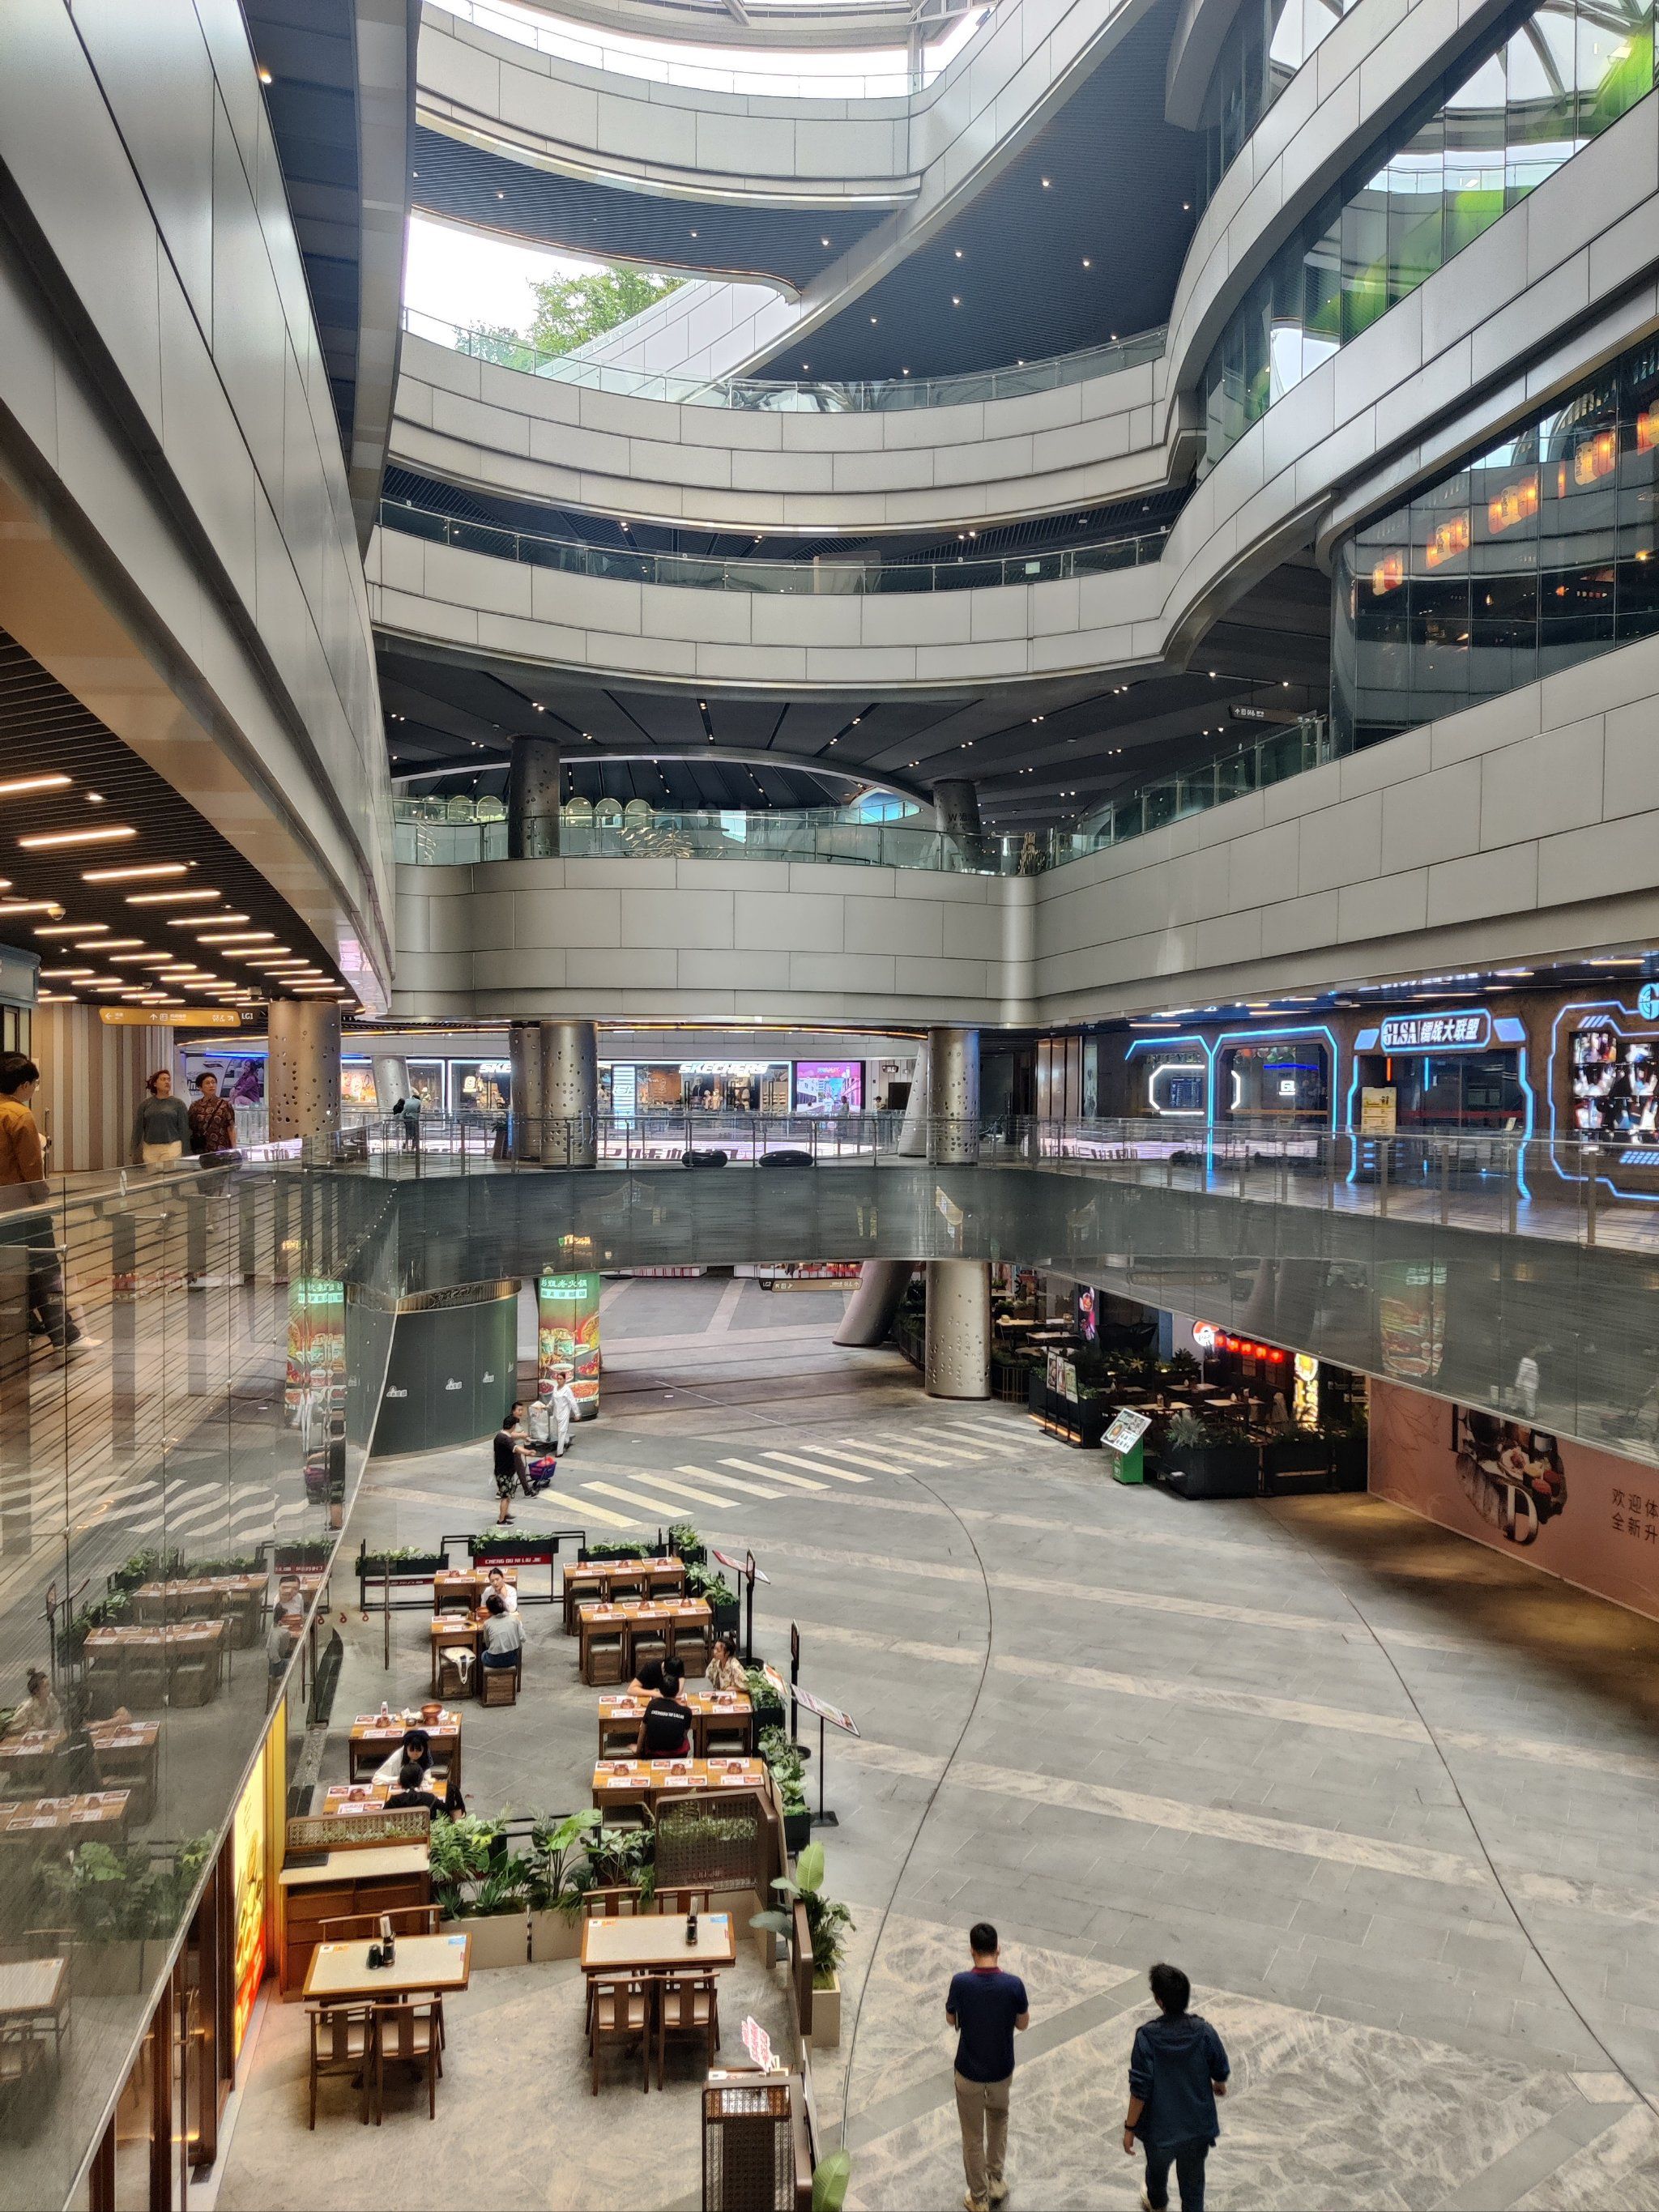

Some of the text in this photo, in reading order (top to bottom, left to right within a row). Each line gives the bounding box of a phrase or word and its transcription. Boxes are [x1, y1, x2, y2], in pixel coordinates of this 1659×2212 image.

[1382, 1021, 1418, 1046] GLSA
[678, 1063, 770, 1075] SKECHERS
[1611, 1488, 1659, 1519] 欢迎体
[1611, 1512, 1659, 1545] 全新升
